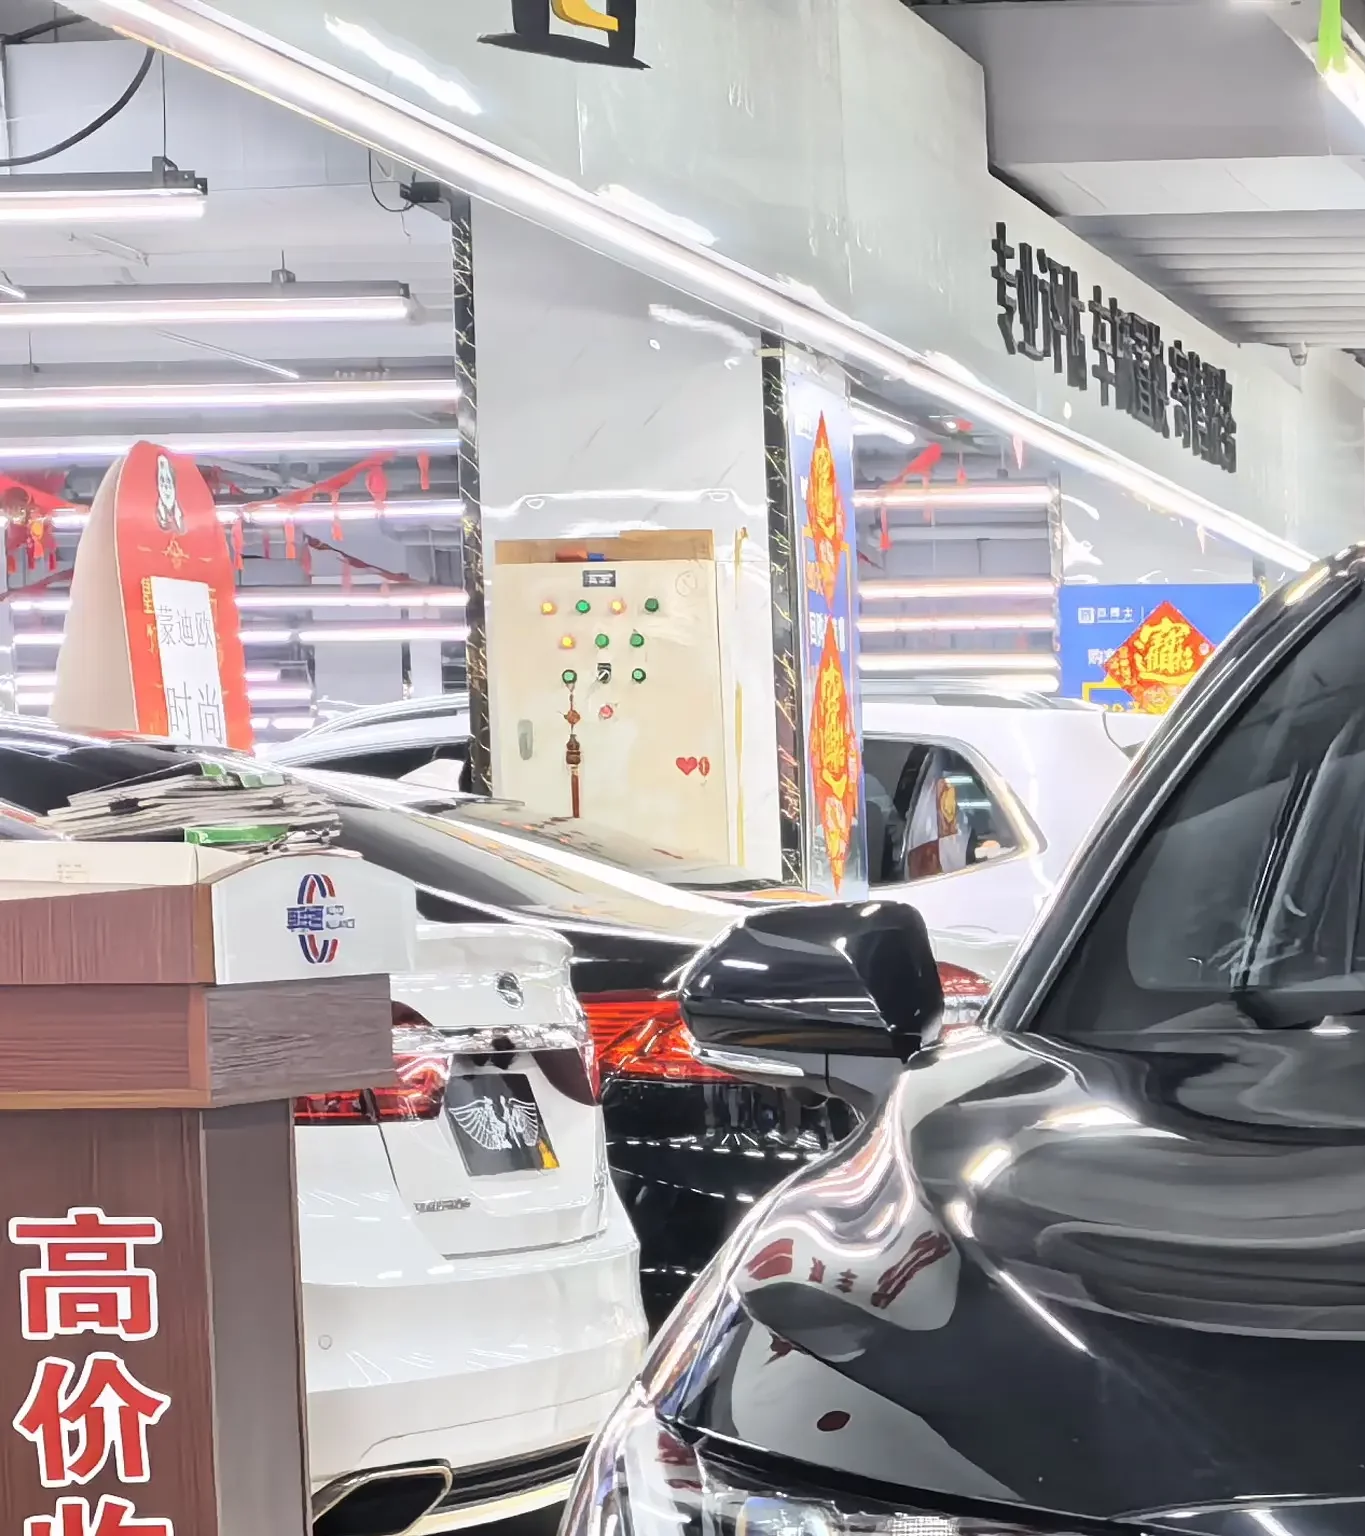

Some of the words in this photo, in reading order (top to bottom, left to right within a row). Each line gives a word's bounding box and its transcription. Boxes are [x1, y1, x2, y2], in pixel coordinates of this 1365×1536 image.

[157, 605, 214, 648] 蒙迪欧
[166, 681, 224, 745] 时尚
